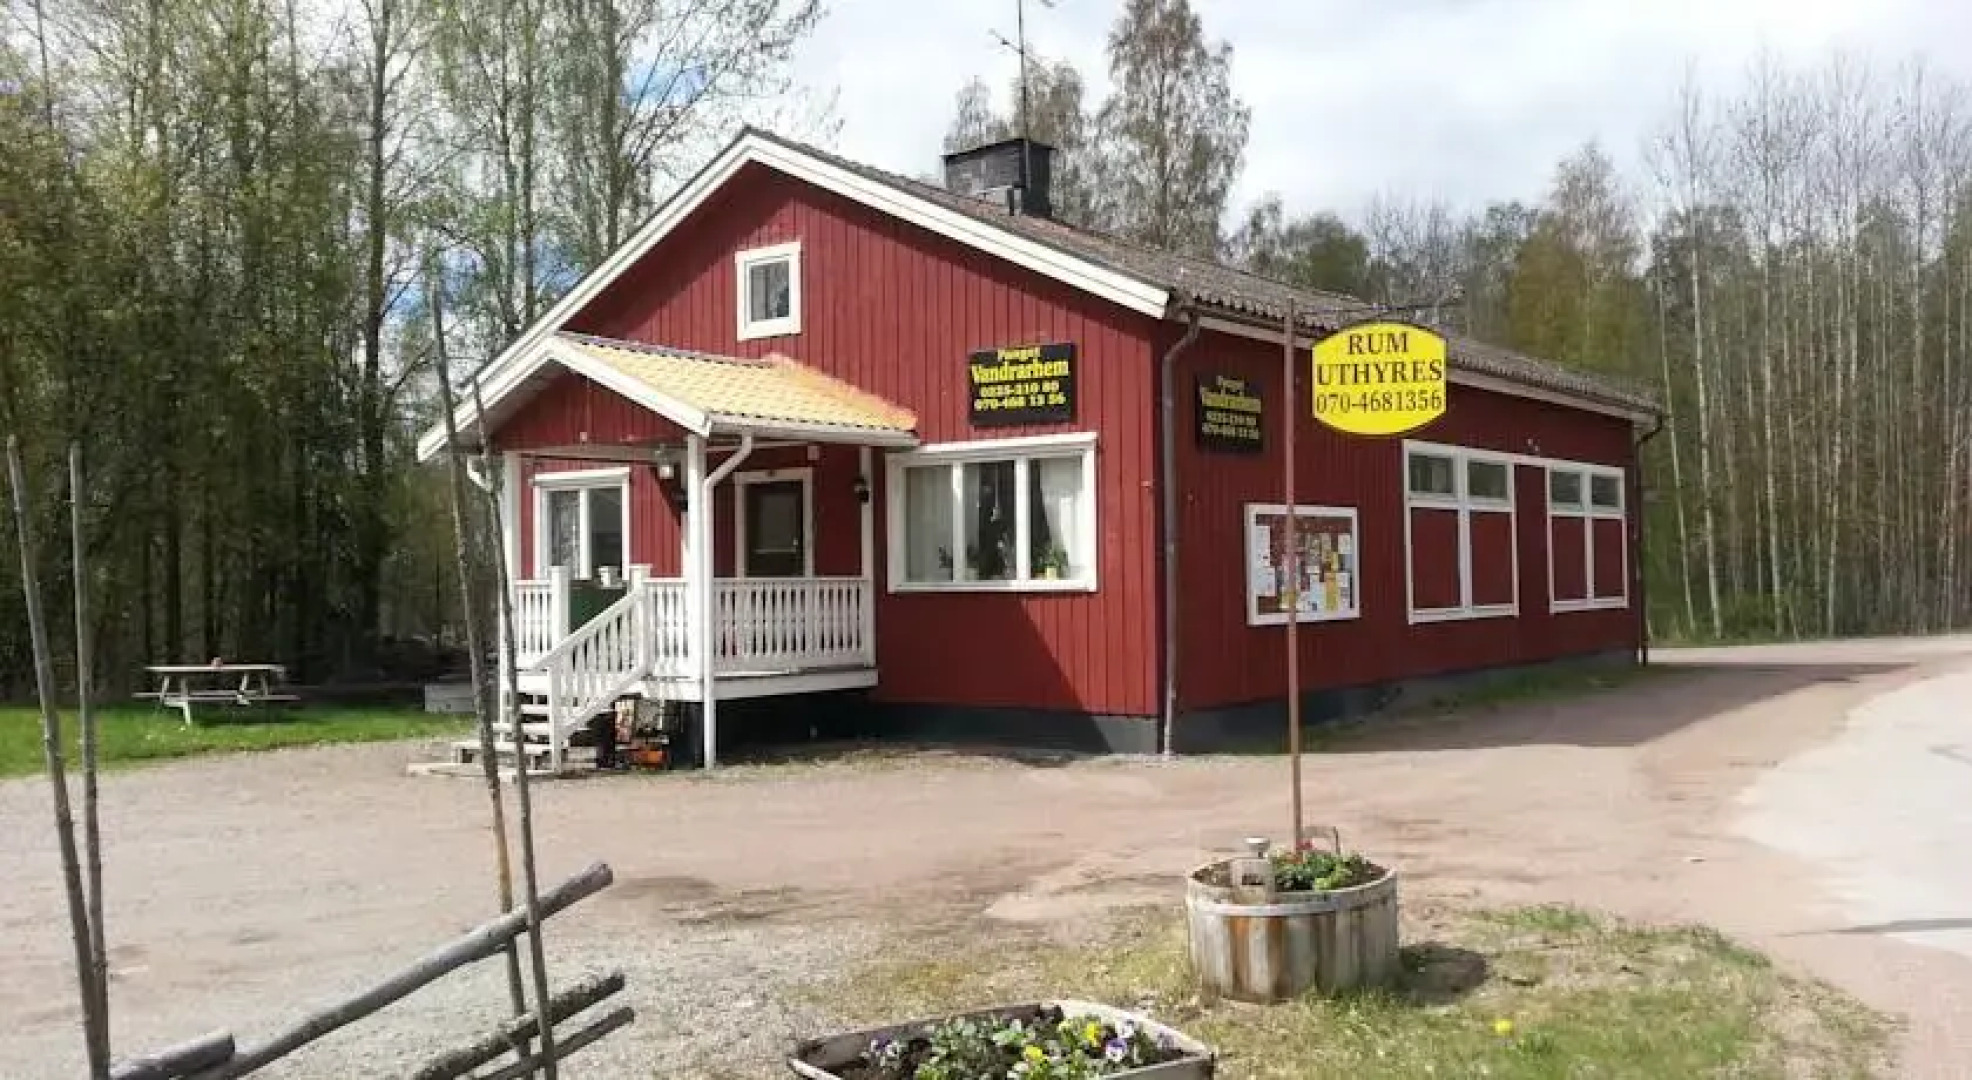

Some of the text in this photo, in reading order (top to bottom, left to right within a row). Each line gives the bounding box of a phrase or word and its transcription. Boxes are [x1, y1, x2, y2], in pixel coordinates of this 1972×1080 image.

[1349, 332, 1408, 355] RUM
[971, 359, 1069, 385] Vandrarhem
[1316, 359, 1442, 385] UTHYRES
[1316, 389, 1442, 414] 070-4681356
